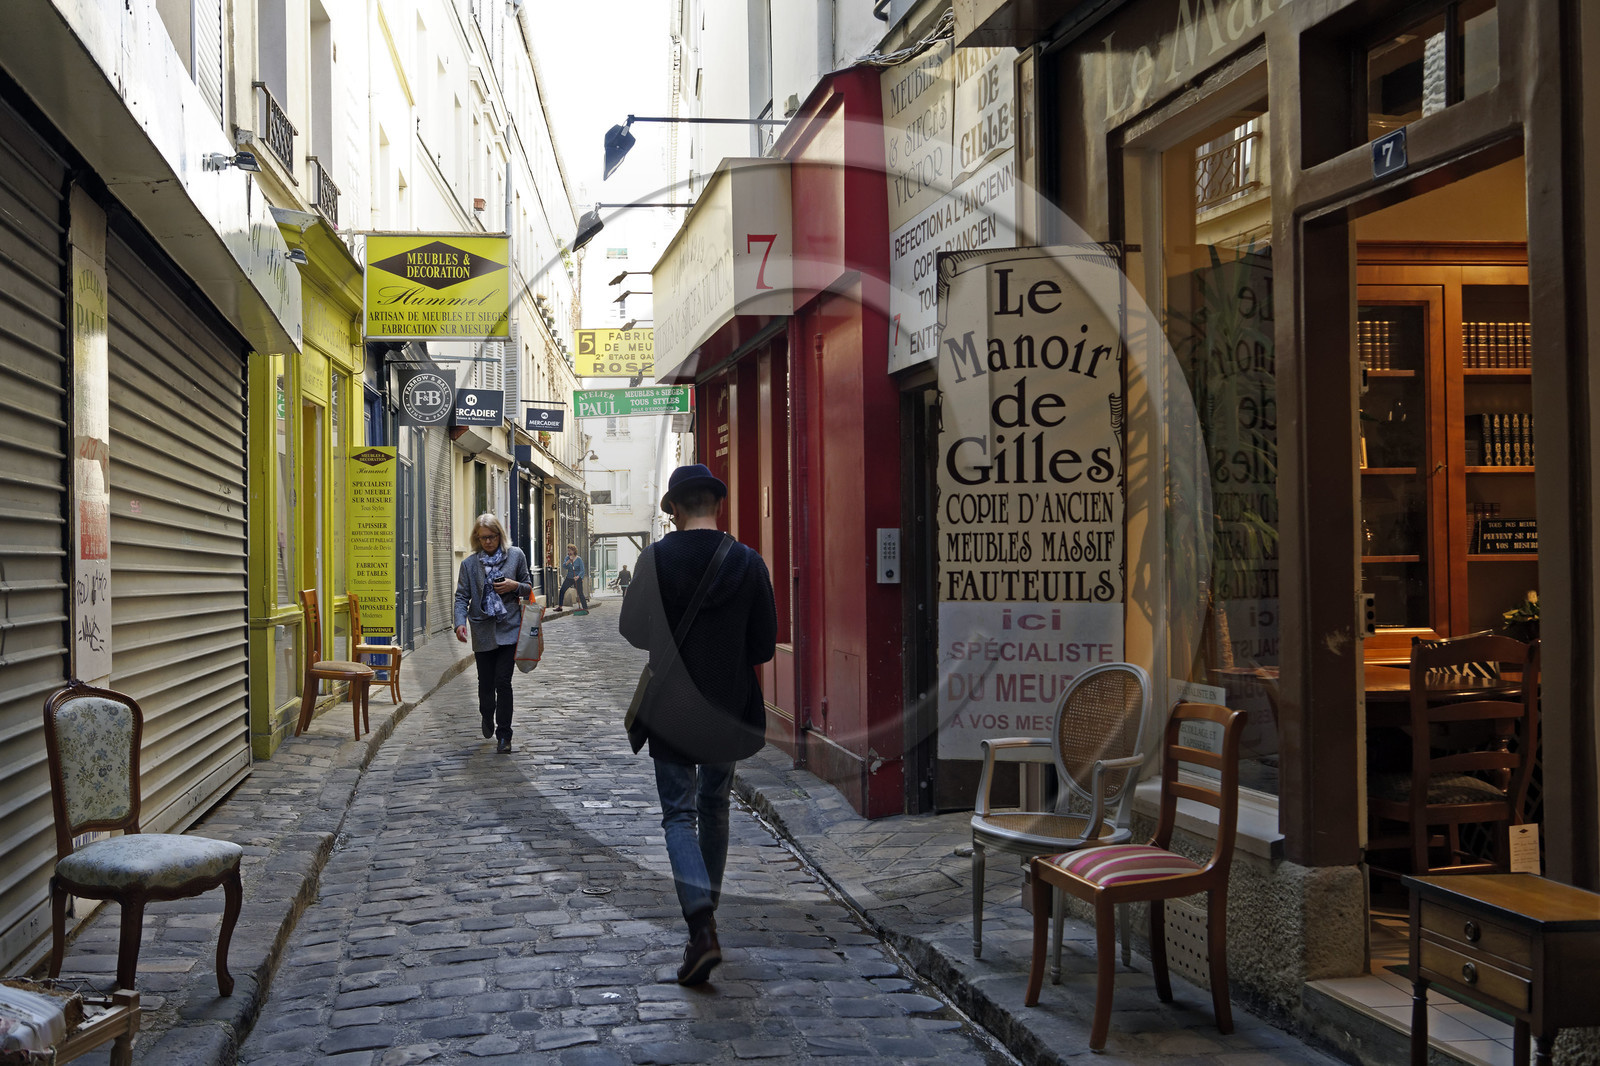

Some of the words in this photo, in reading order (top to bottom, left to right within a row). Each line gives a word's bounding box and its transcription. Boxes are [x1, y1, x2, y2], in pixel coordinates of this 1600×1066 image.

[890, 53, 943, 118] MEUBLES
[976, 64, 1000, 113] DE
[1101, 31, 1155, 121] Le
[889, 136, 899, 168] &
[904, 95, 947, 157] SIEGES
[1382, 141, 1394, 167] 7
[895, 146, 943, 208] VICTOR
[894, 208, 944, 261] REFECTION
[945, 203, 953, 226] A
[407, 252, 459, 265] MEUBLES
[463, 253, 471, 266] &
[913, 246, 941, 282] COPI
[945, 212, 997, 253] D'ANCIEN
[406, 266, 471, 279] DECORATION
[746, 233, 778, 290] 7
[376, 285, 500, 306] Hummel
[993, 268, 1063, 318] Le
[368, 311, 405, 321] ARTISAN
[408, 311, 419, 321] DE
[422, 311, 463, 321] MEUBLES
[465, 312, 476, 321] ET
[479, 311, 508, 321] SIEGES
[381, 323, 437, 334] FABRICATION
[440, 324, 458, 334] SUR
[460, 324, 496, 335] MESURE
[893, 313, 902, 347] 7
[580, 334, 595, 354] 5
[604, 343, 619, 352] DE
[628, 343, 652, 352] MEU
[943, 323, 1113, 384] Manoir
[592, 362, 654, 373] ROSE
[404, 375, 429, 395] FARROW
[436, 379, 449, 395] BALL
[414, 390, 442, 406] F&B
[578, 390, 616, 402] ATELIER
[624, 390, 655, 398] MEUBLES
[661, 388, 685, 397] SIEGES
[578, 401, 620, 417] PAUL
[630, 398, 650, 407] TOUS
[652, 397, 680, 406] STYLES
[991, 376, 1067, 429] de
[528, 419, 560, 427] MERCADIER
[356, 467, 389, 475] Hummel
[946, 431, 1115, 486] Gilles
[945, 492, 1009, 525] COPIE
[1017, 491, 1115, 524] D'ANCIEN
[946, 530, 1032, 564] MEUBLES
[1041, 529, 1115, 562] MASSIF
[1495, 542, 1509, 550] VOS
[946, 569, 1116, 603] FAUTEUILS
[1002, 608, 1061, 631] ici
[951, 637, 1115, 663] SPÉCIALISTE
[947, 673, 986, 702] DU
[971, 713, 1010, 731] VOS
